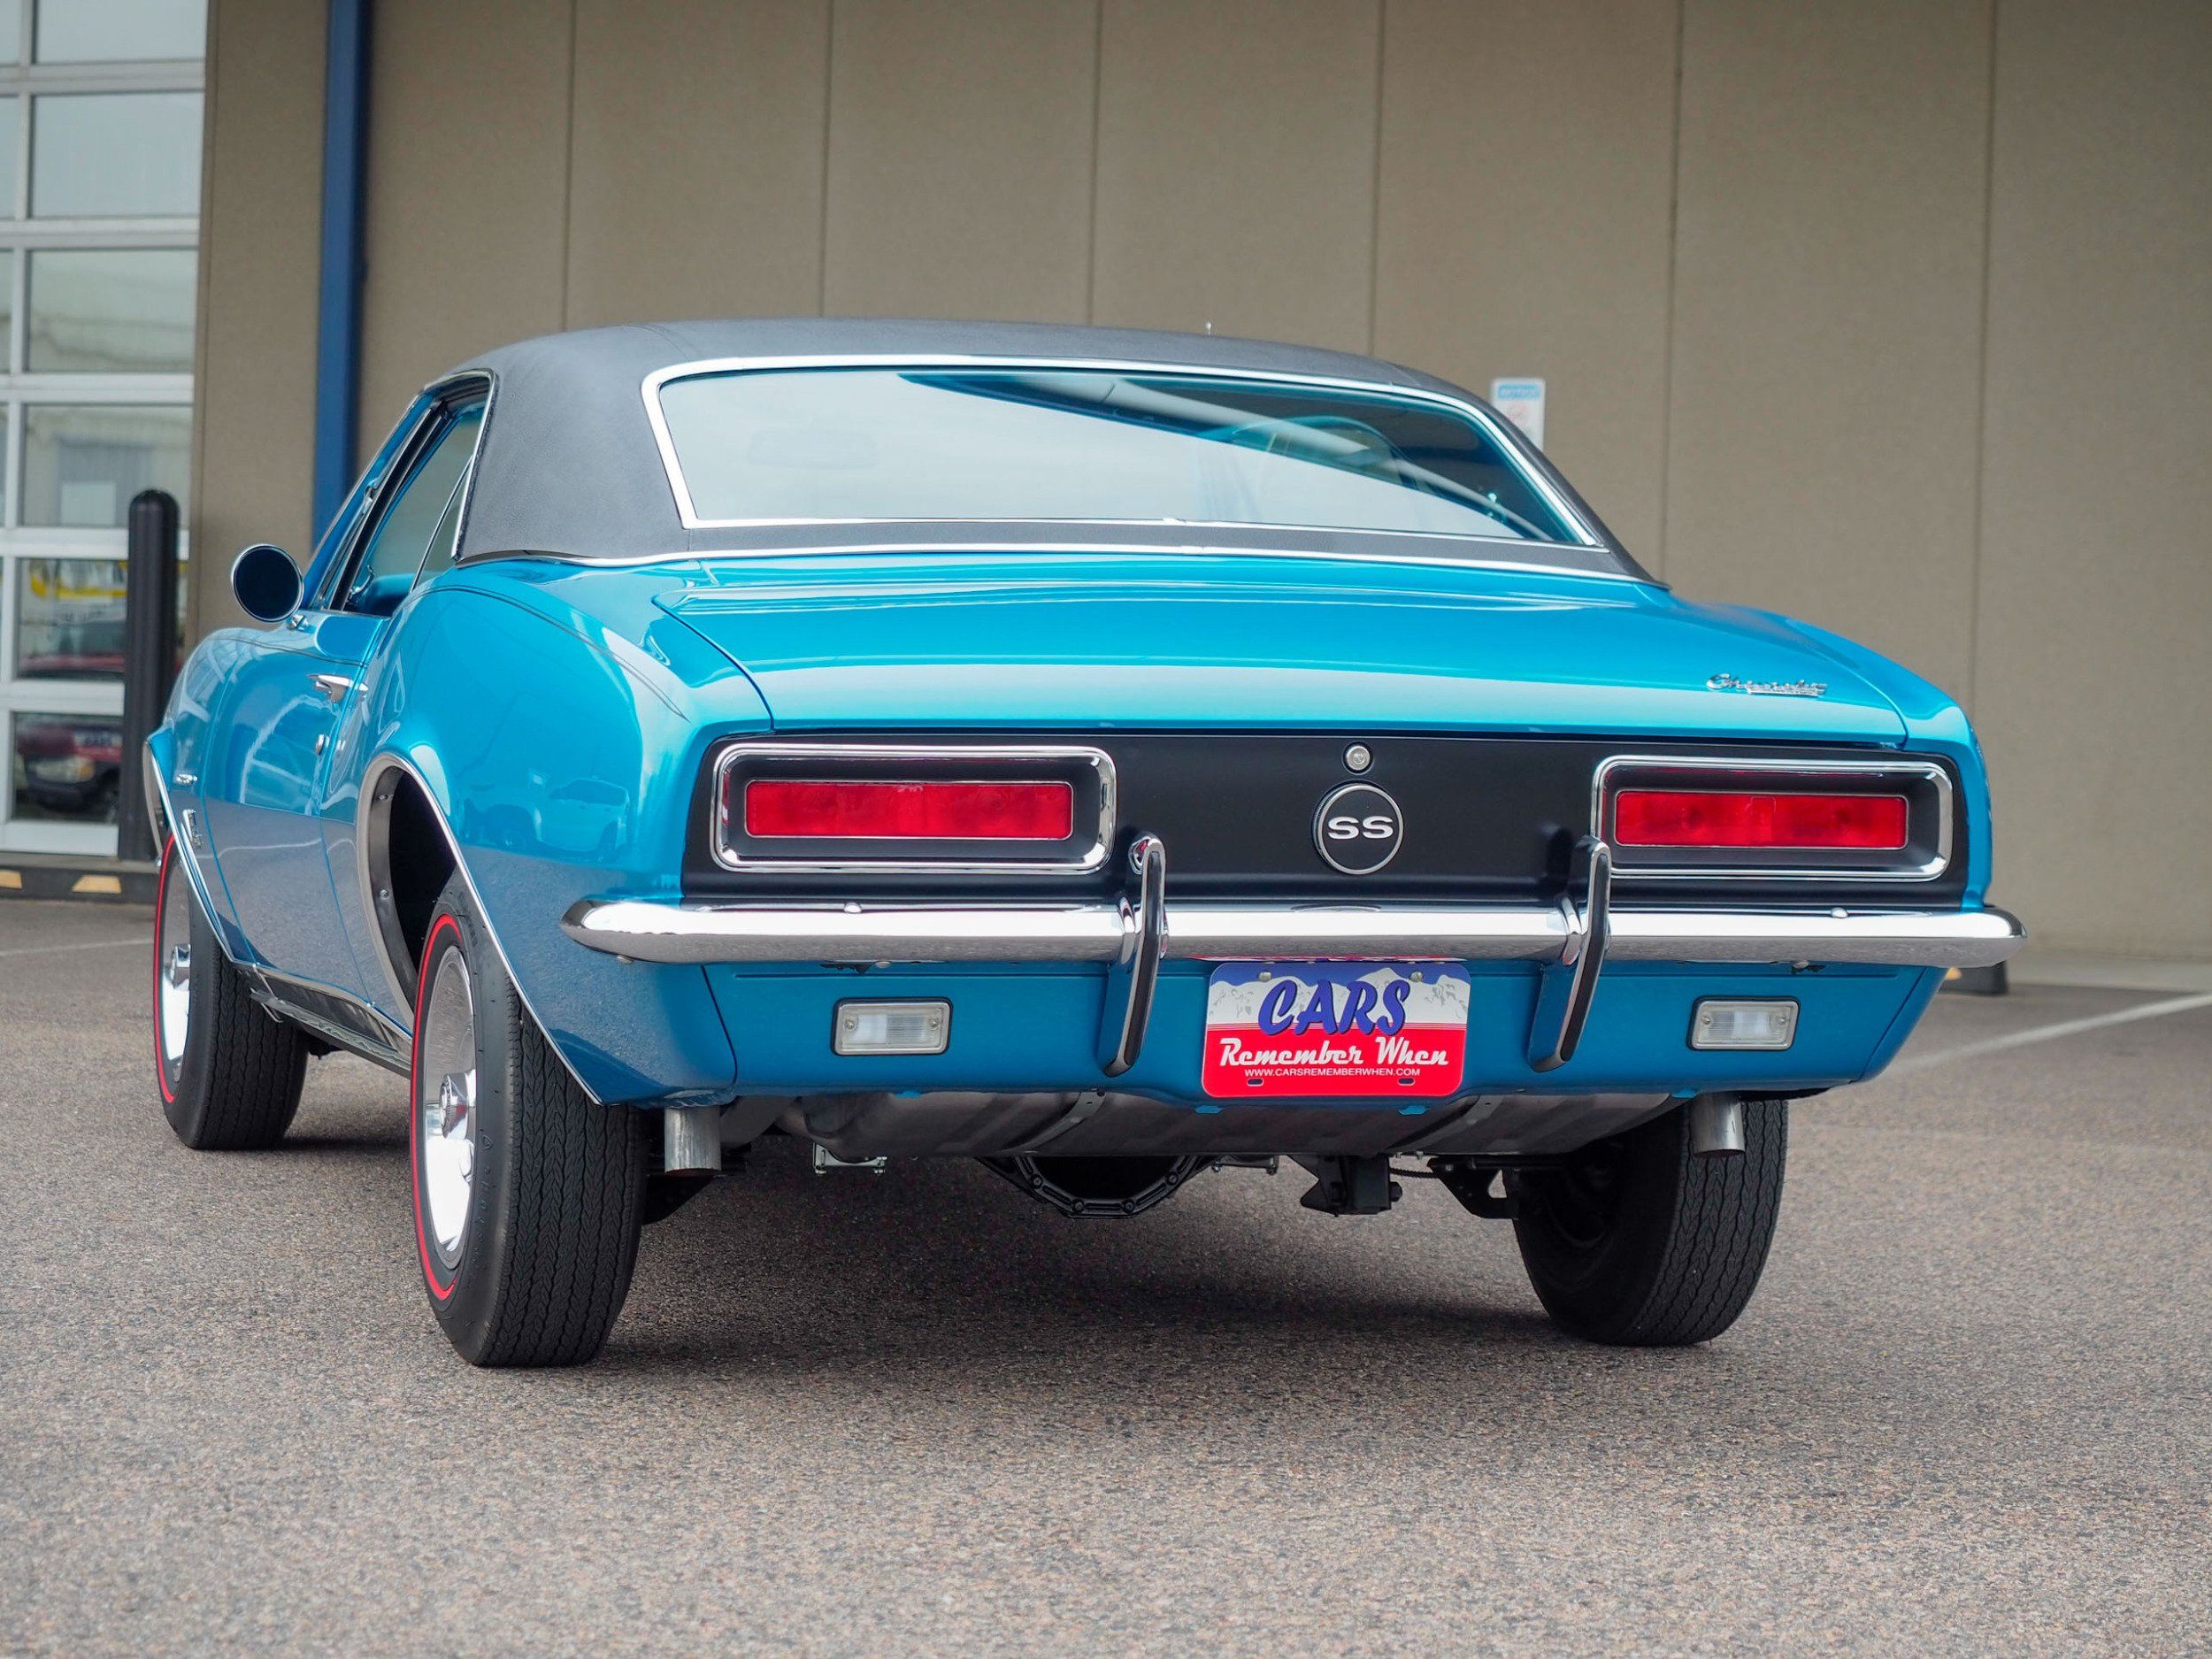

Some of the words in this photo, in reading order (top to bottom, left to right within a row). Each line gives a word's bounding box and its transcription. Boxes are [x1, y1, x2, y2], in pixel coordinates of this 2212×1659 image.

[1327, 816, 1394, 840] SS
[1257, 979, 1411, 1036] CARS
[1219, 1038, 1363, 1066] Remember
[1375, 1036, 1448, 1065] When
[1245, 1067, 1421, 1077] WWW.CARSREMEMBERWHEN.COM
